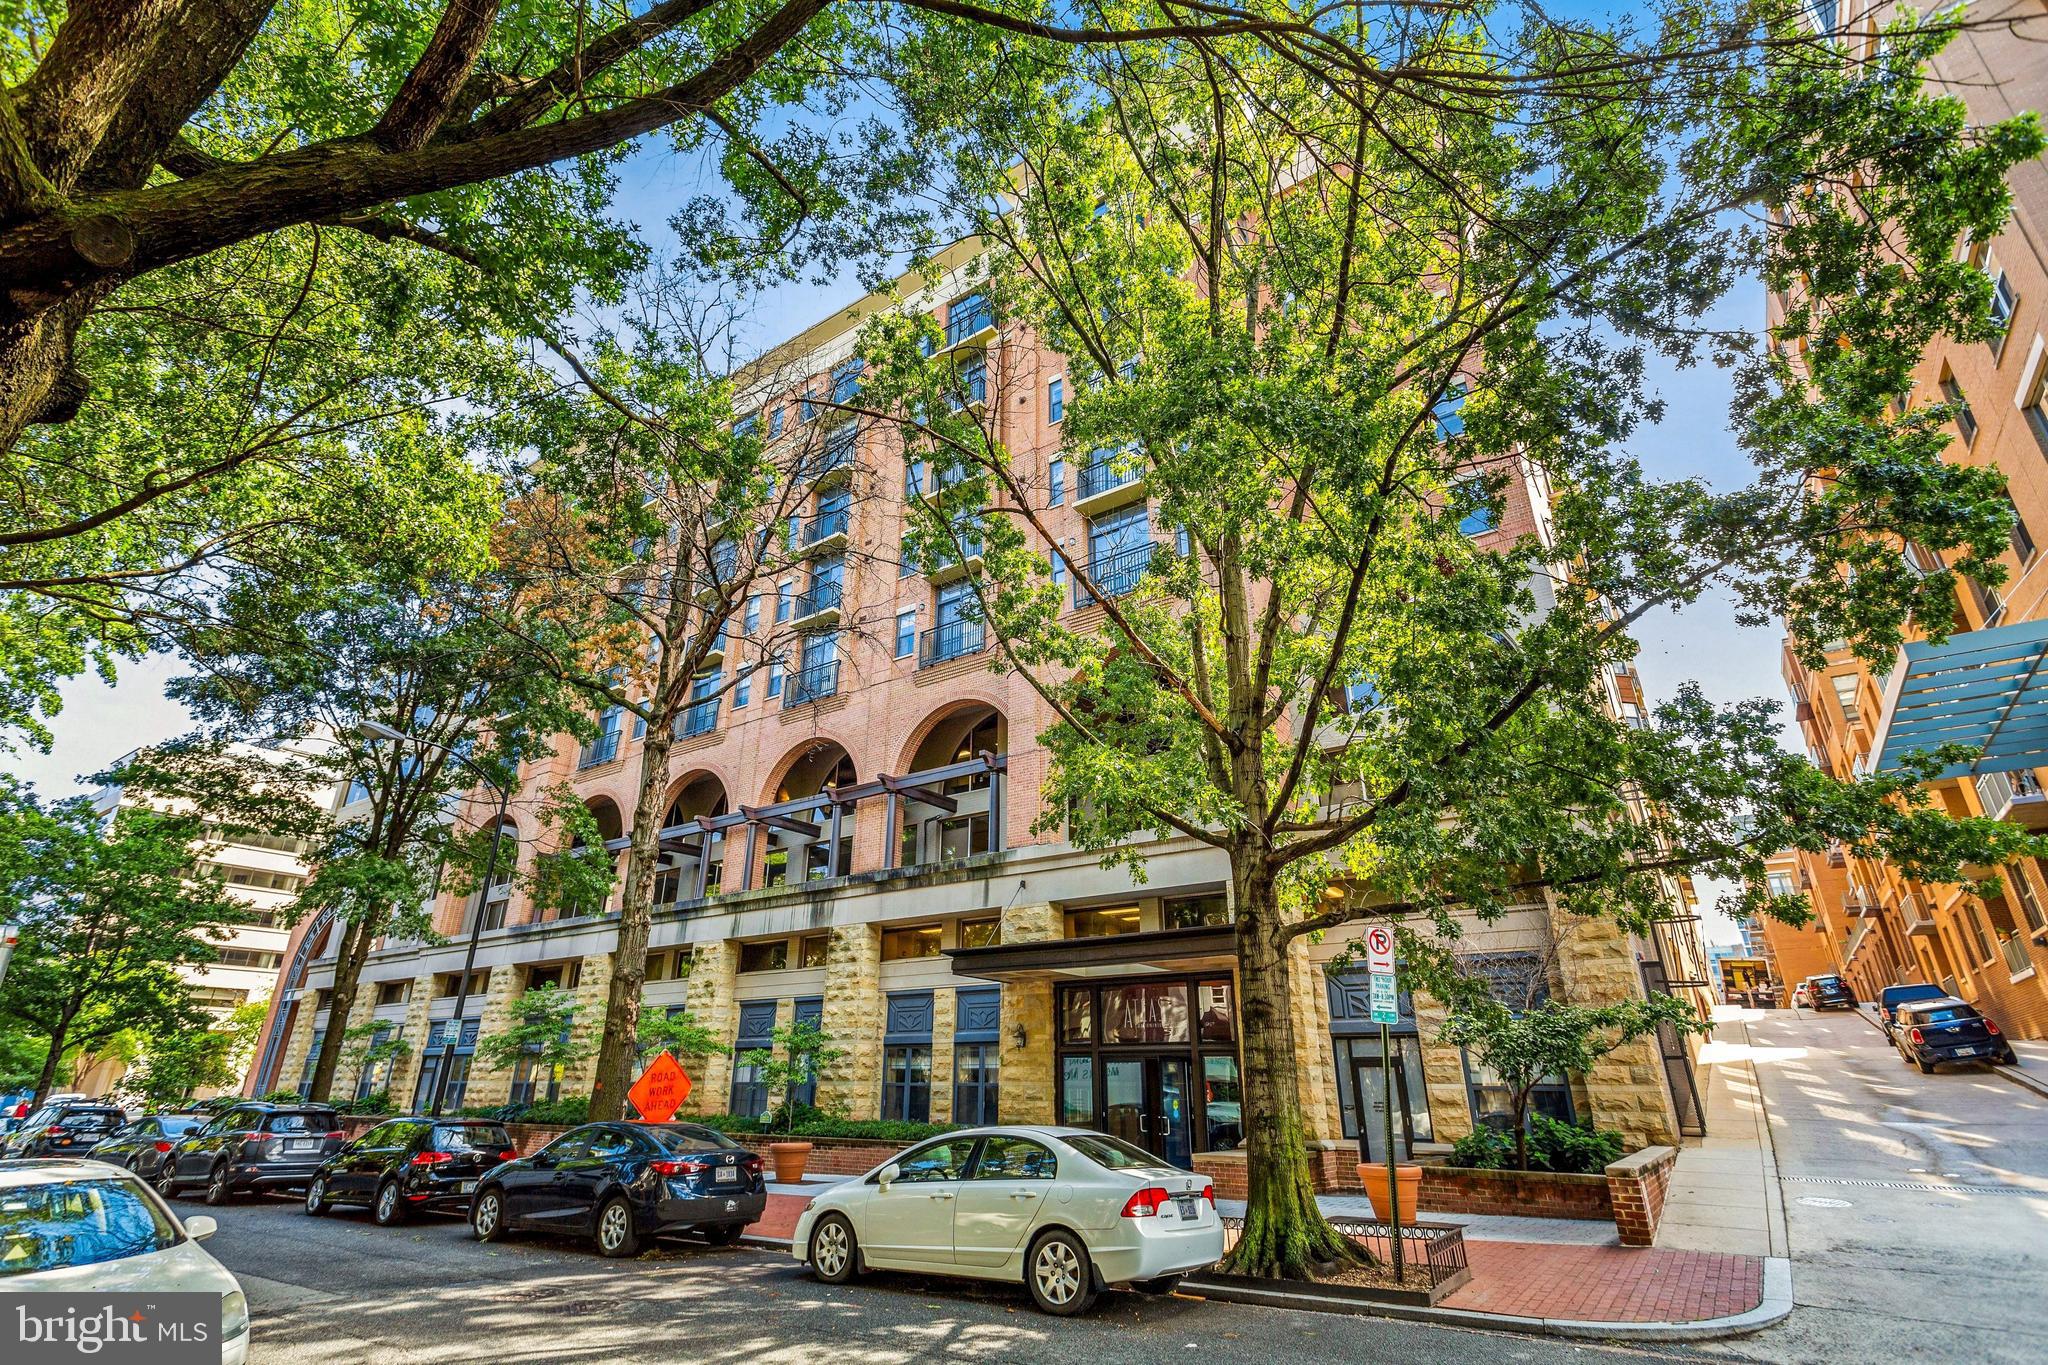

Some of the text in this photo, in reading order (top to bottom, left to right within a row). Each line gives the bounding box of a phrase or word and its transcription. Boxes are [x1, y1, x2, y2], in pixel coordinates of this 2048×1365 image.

[651, 1071, 676, 1083] ROAD
[649, 1085, 674, 1097] WORK
[643, 1099, 676, 1112] AHEAD
